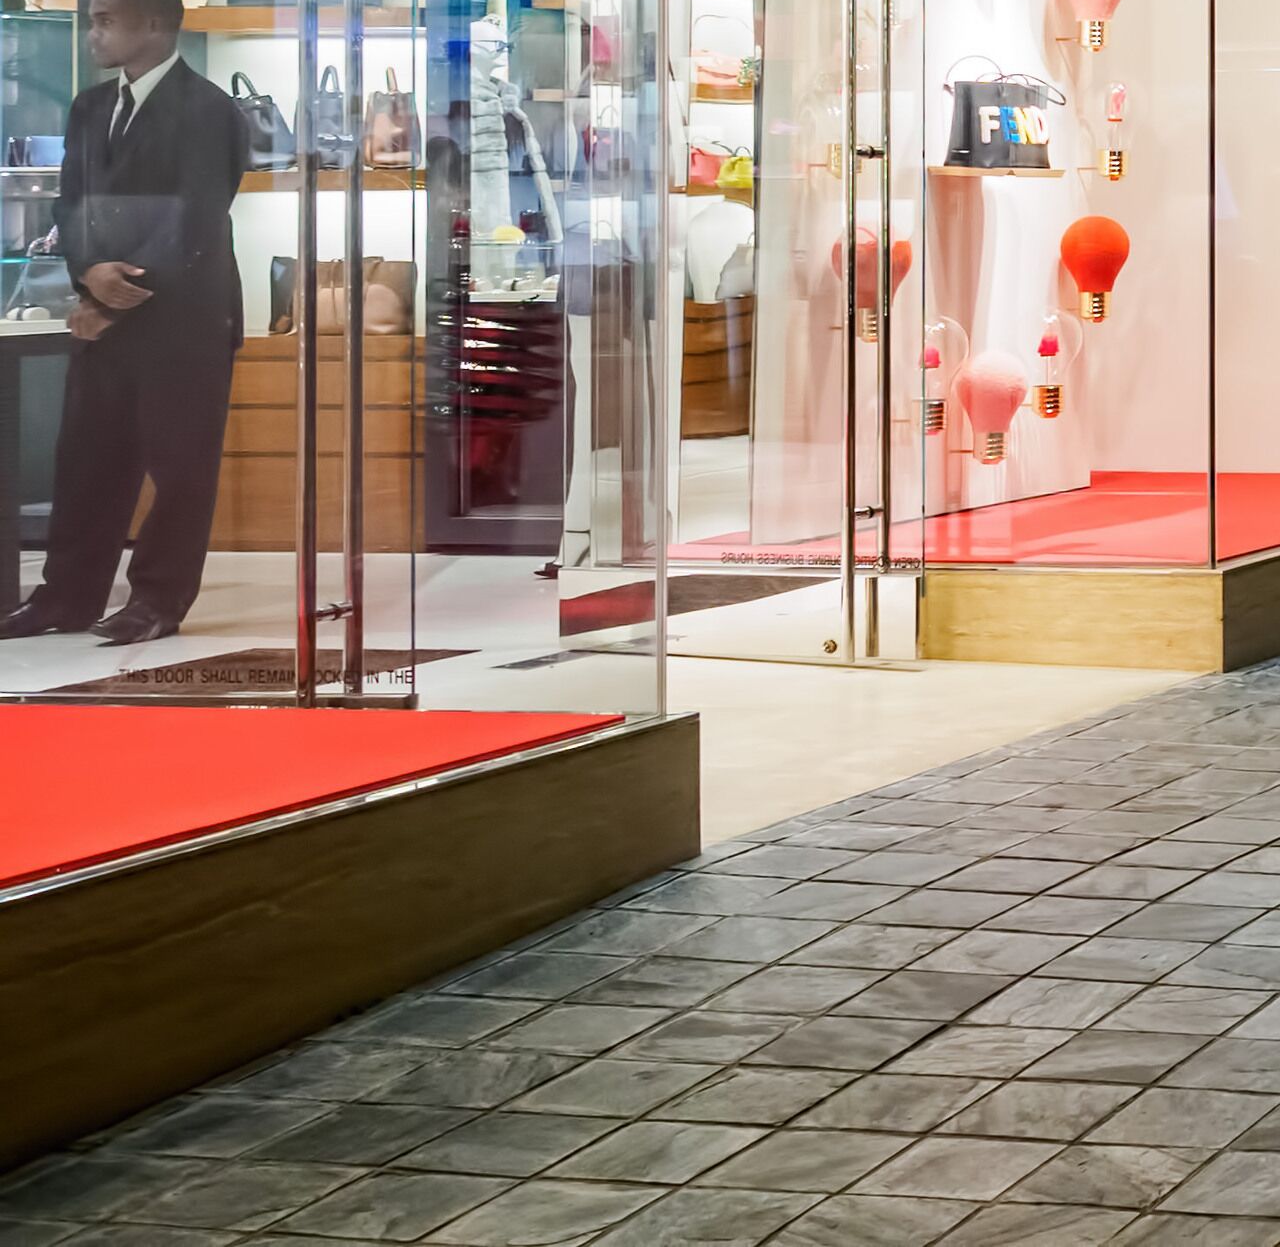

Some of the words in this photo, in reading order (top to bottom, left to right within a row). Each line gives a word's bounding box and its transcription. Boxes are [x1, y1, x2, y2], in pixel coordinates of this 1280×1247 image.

[979, 105, 1049, 145] FEND
[155, 668, 194, 684] DOOR
[201, 668, 244, 684] SHALL
[367, 670, 380, 684] IN
[389, 669, 415, 684] THE
